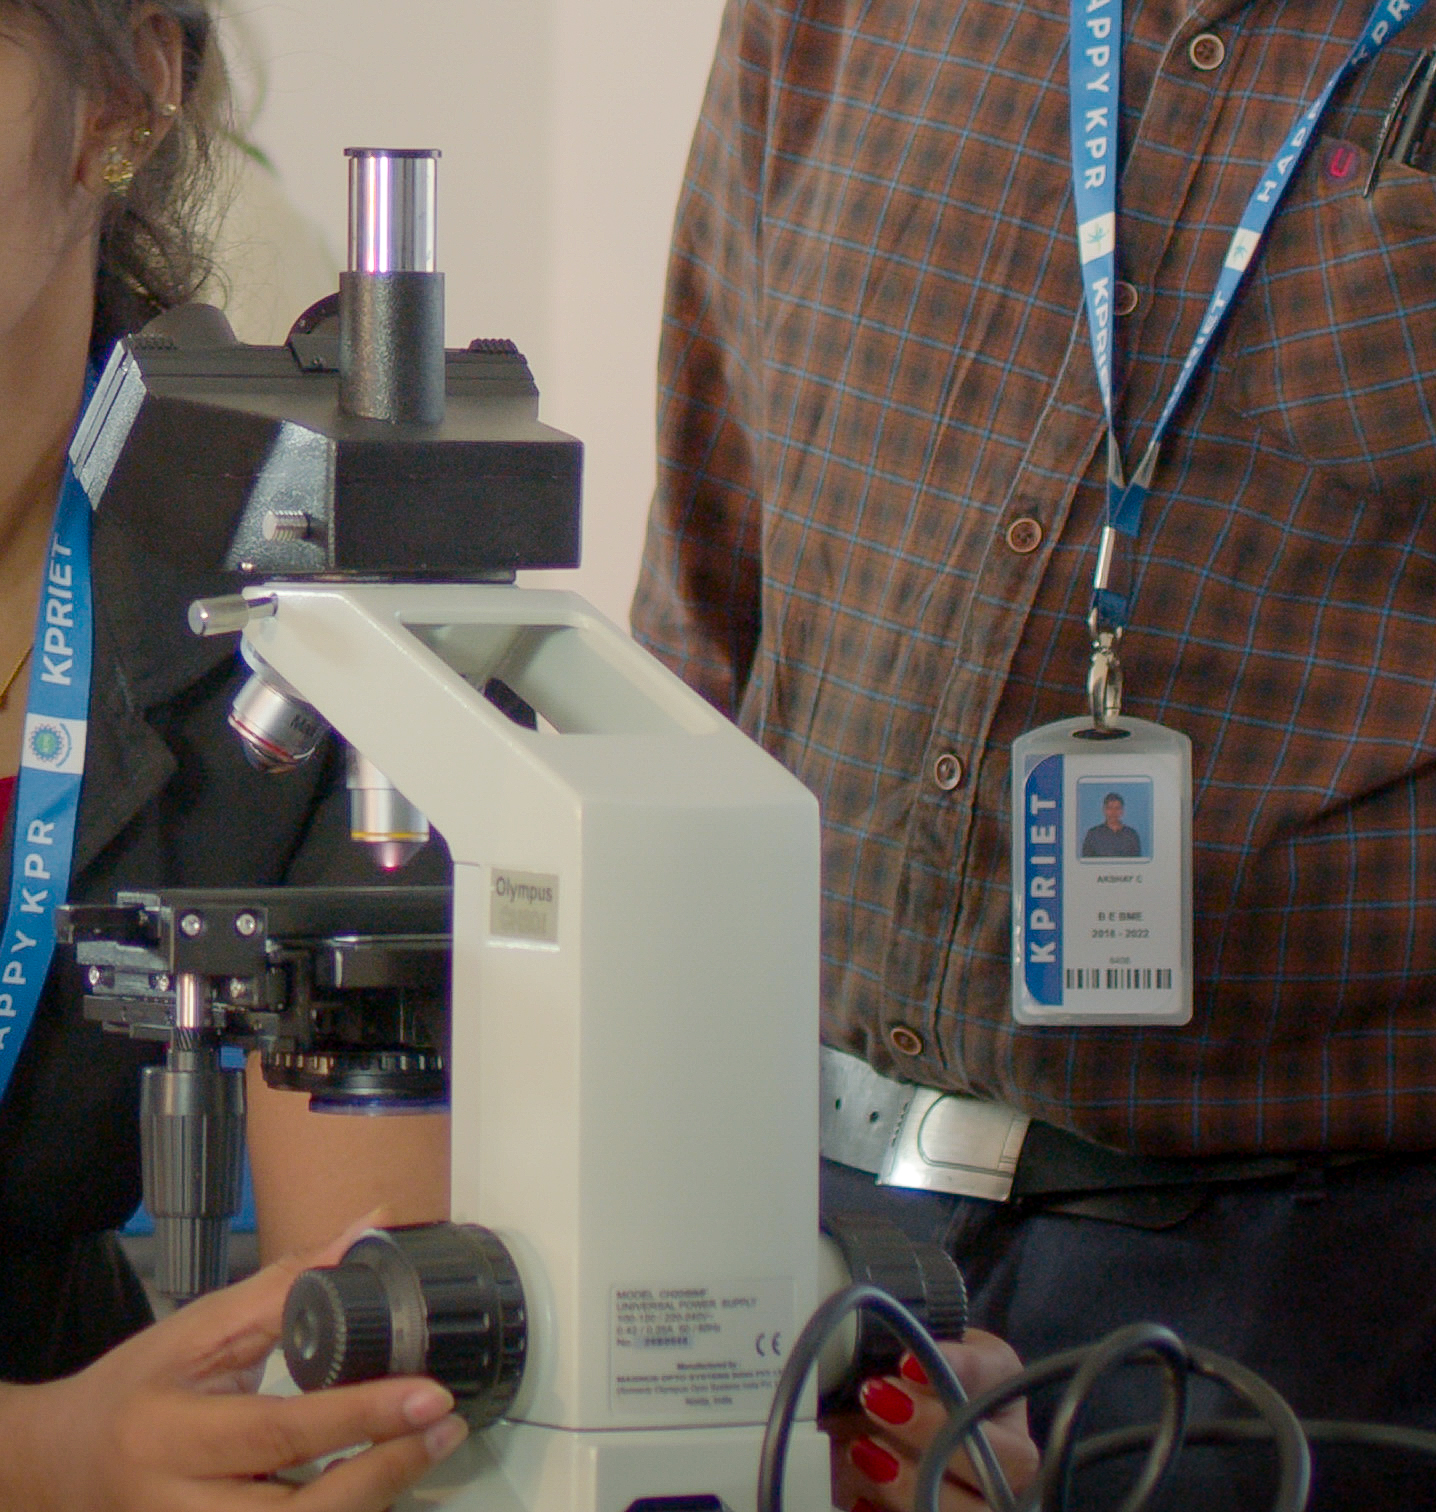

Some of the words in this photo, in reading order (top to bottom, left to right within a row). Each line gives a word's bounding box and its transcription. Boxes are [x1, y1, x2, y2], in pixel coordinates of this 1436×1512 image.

[1083, 106, 1109, 191] KPR
[40, 535, 73, 685] KPRIET
[19, 819, 55, 915] KPR
[496, 876, 553, 904] Olympus
[1031, 794, 1057, 963] KPRIET
